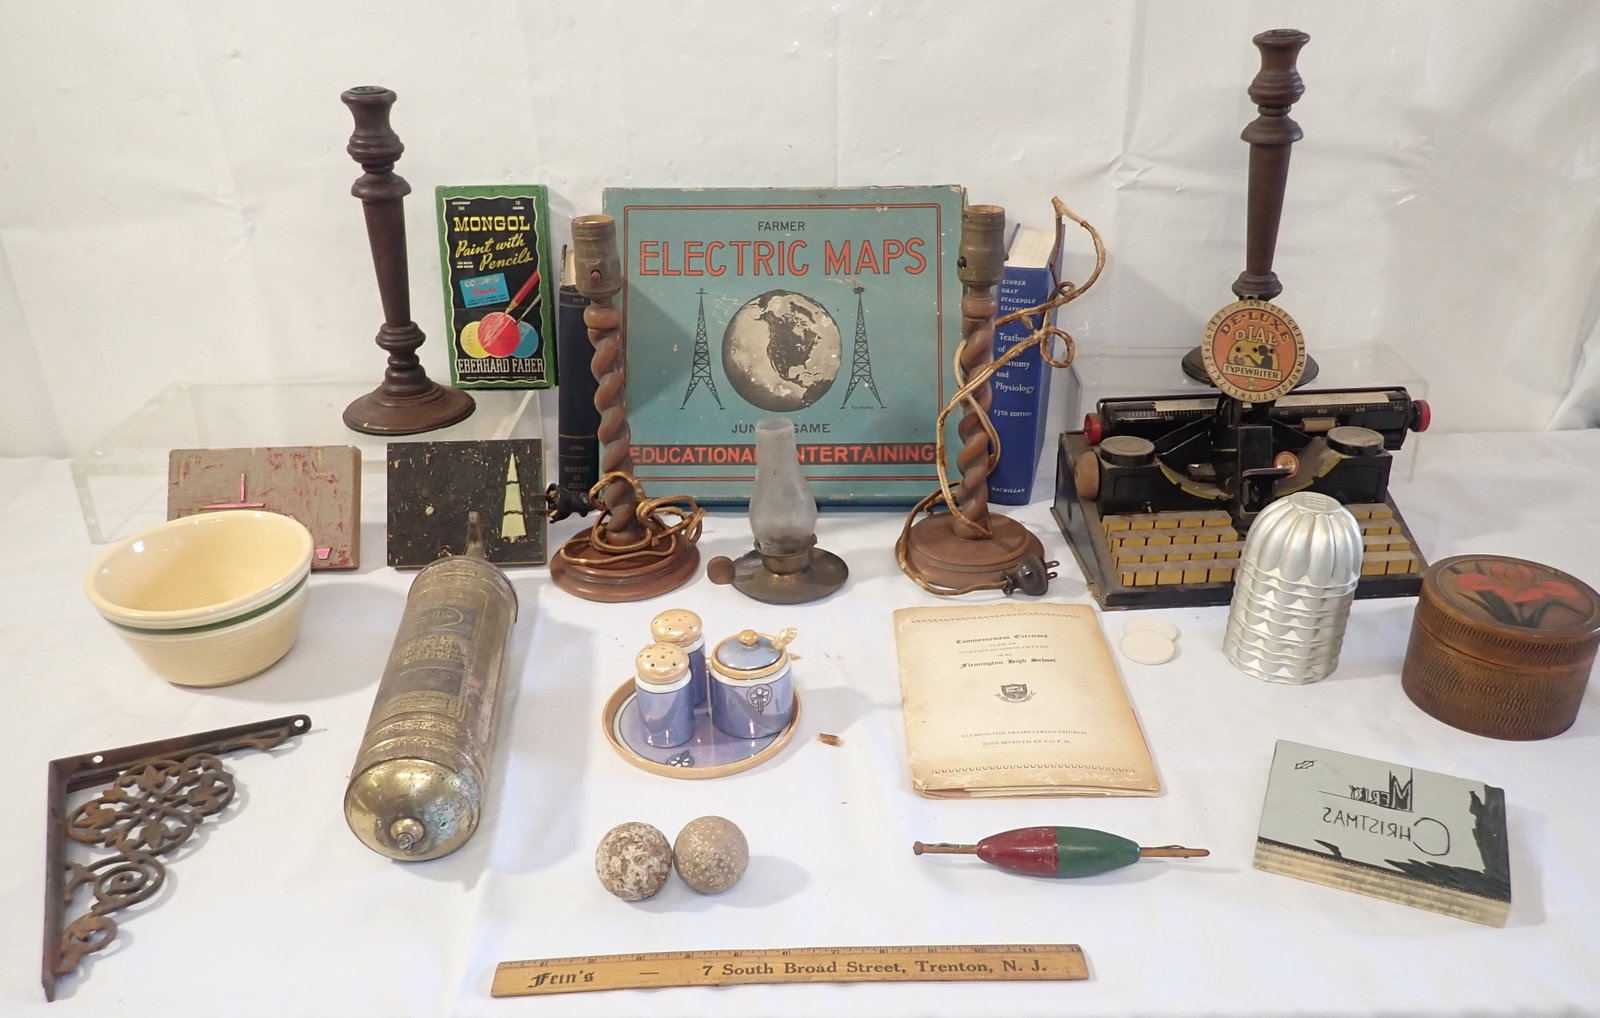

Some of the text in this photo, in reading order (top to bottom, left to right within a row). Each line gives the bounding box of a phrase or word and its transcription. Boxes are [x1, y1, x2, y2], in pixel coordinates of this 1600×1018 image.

[453, 216, 530, 232] MONGOL
[758, 221, 806, 232] FARMER
[455, 232, 526, 258] Paint with
[479, 247, 534, 272] Pencils
[639, 238, 928, 276] ELECTRIC MAPS
[999, 332, 1033, 342] Textbo
[1234, 326, 1278, 346] DIAL
[458, 358, 545, 374] EBERHARD FABER
[1004, 360, 1031, 370] atomy
[1225, 364, 1280, 380] TYPEWRITER
[996, 370, 1010, 378] and
[995, 381, 1035, 395] Physiology
[731, 424, 757, 434] JUN
[796, 444, 934, 462] NTERTAINING
[956, 635, 1010, 644] Commencement
[960, 660, 1004, 668] Flemington
[527, 970, 595, 988] Fein's
[702, 966, 714, 976] 7
[722, 963, 774, 976] South
[784, 962, 837, 974] Broad
[846, 961, 906, 974] Street,
[915, 960, 993, 974] Trenton,
[1002, 960, 1022, 972] N.
[1032, 960, 1046, 972] J.
